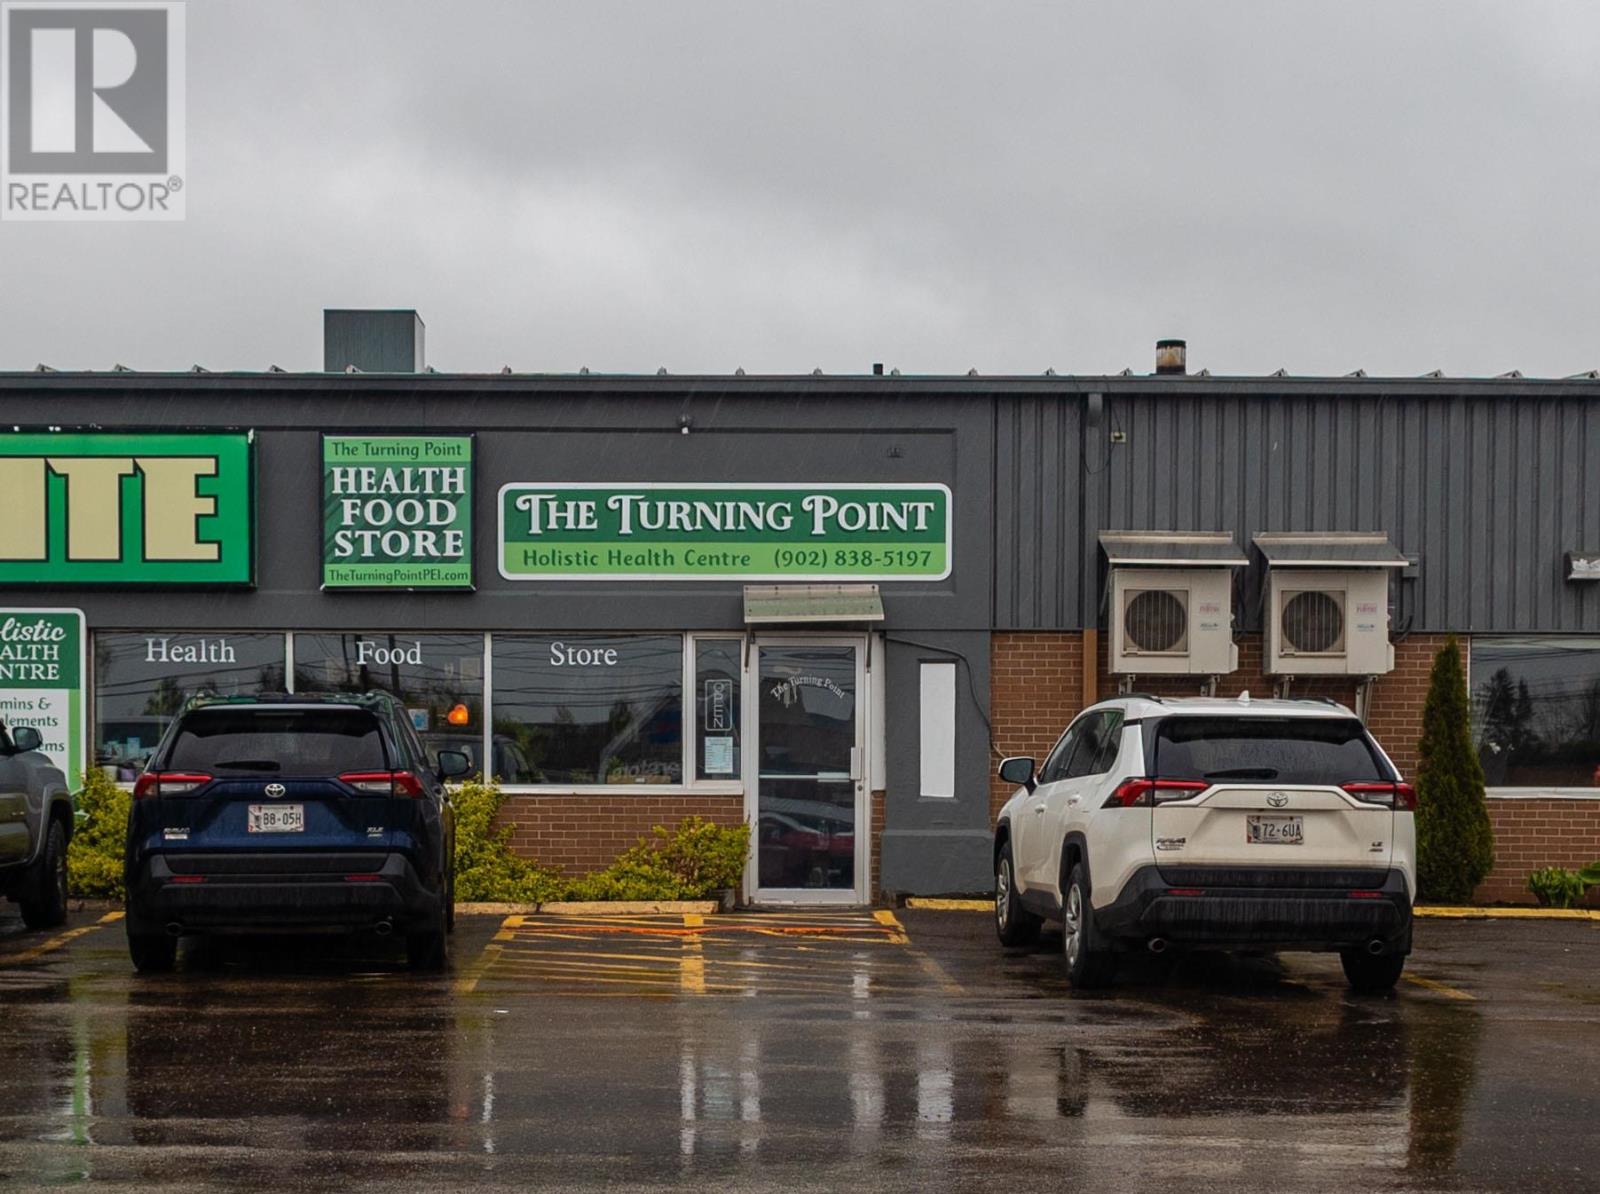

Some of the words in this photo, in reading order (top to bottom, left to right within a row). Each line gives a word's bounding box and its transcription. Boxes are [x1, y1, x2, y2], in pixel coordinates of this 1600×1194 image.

[332, 441, 358, 456] The
[362, 441, 419, 460] Turning
[425, 441, 462, 456] Point
[332, 467, 466, 494] HEALTH
[340, 499, 457, 526] FOOD
[516, 494, 598, 534] THE
[607, 494, 794, 535] TURNING
[801, 495, 935, 535] POINT
[334, 530, 464, 557] STORE
[523, 549, 599, 567] Holistic
[608, 549, 675, 567] Health
[684, 549, 751, 567] Centre
[774, 548, 828, 568] (902)
[834, 550, 932, 567] 838-5197
[329, 568, 468, 583] TheTurningPointPEI.com
[0, 617, 67, 641] listic
[0, 644, 60, 660] ALTH
[145, 638, 236, 663] Health
[356, 641, 423, 665] Food
[550, 641, 618, 666] Store
[0, 663, 60, 680] NTRE
[770, 682, 789, 698] The
[788, 675, 823, 687] Turning
[824, 678, 845, 698] Point
[0, 696, 33, 711] mins
[38, 697, 52, 710] &
[712, 682, 725, 729] OPEN
[0, 713, 58, 727] lements
